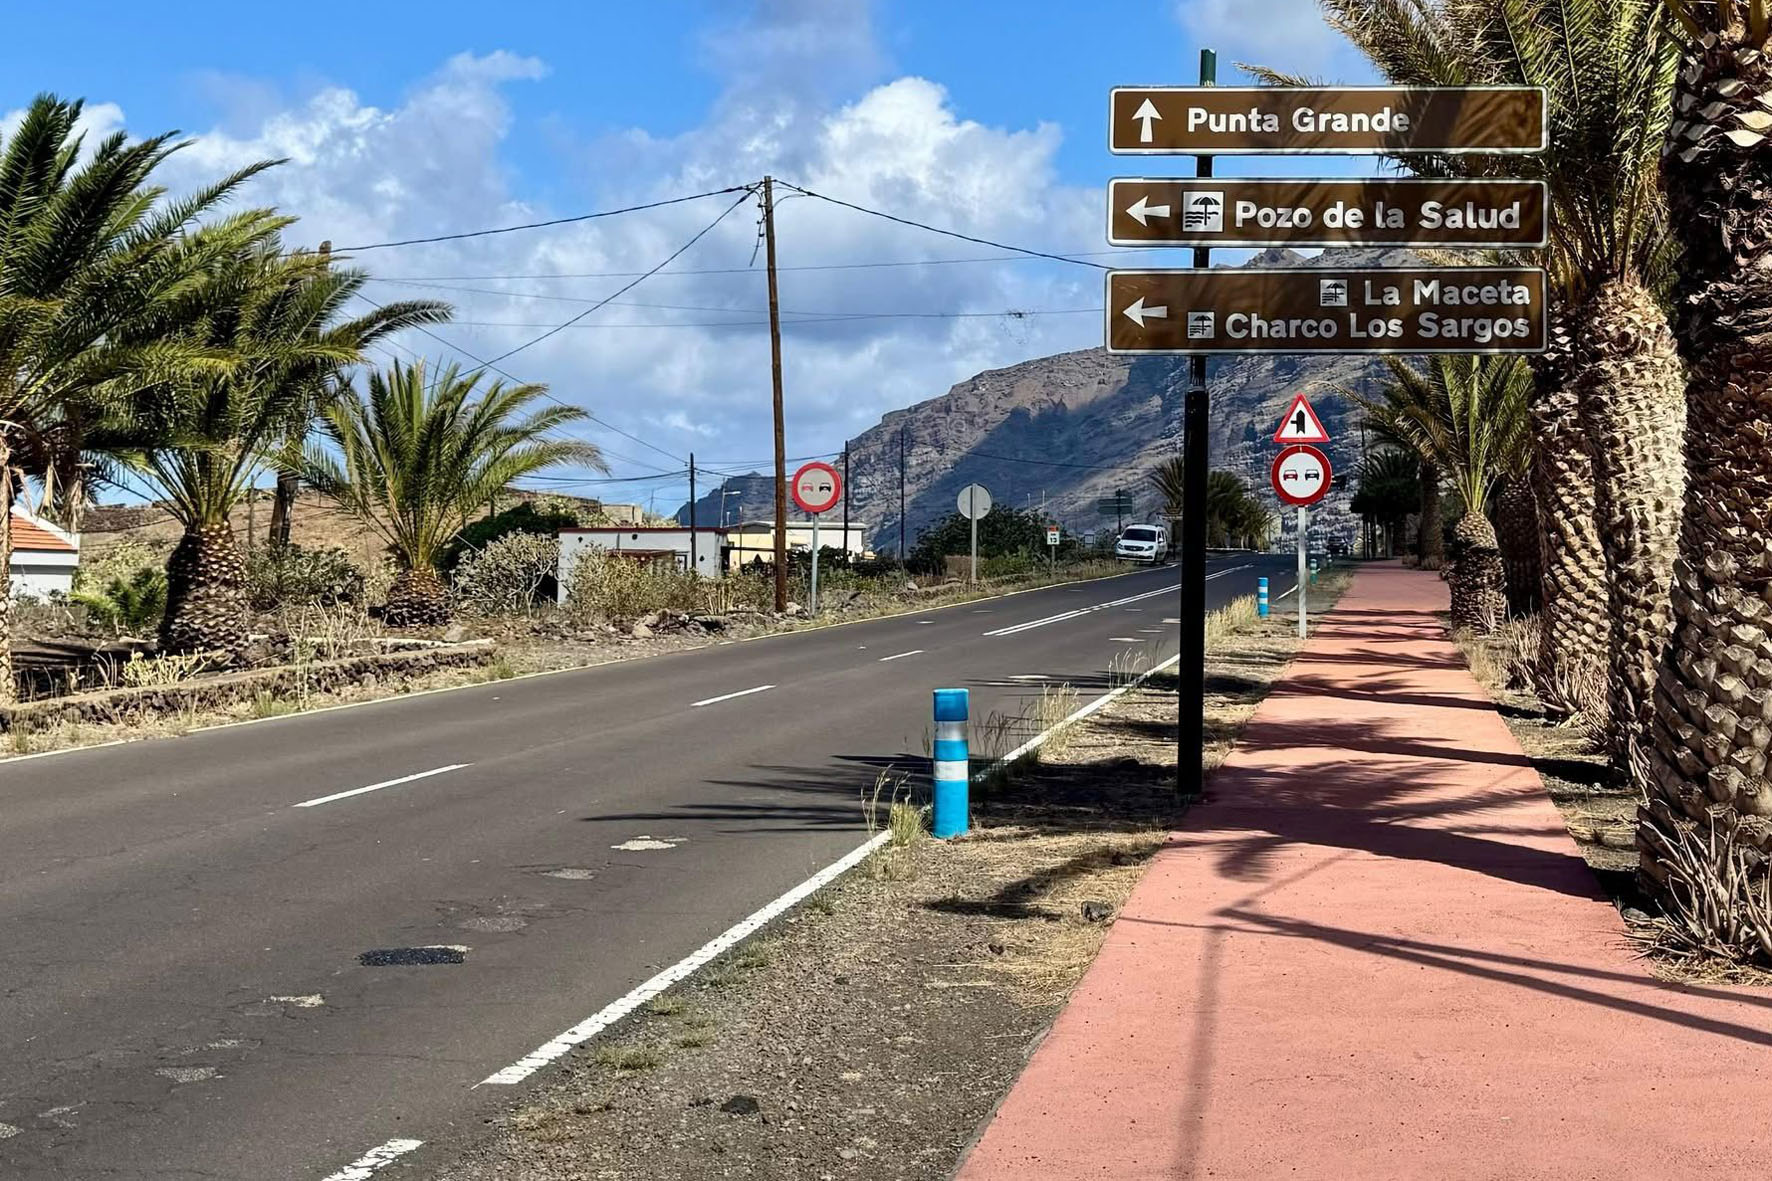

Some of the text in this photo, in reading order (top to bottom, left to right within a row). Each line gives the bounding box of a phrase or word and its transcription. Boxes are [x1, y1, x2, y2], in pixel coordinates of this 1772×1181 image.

[1188, 107, 1409, 132] Punta Grande
[1236, 201, 1520, 229] Pozo de la Salud
[1365, 279, 1530, 305] La Maceta
[1225, 312, 1529, 342] Charco Los Sargos
